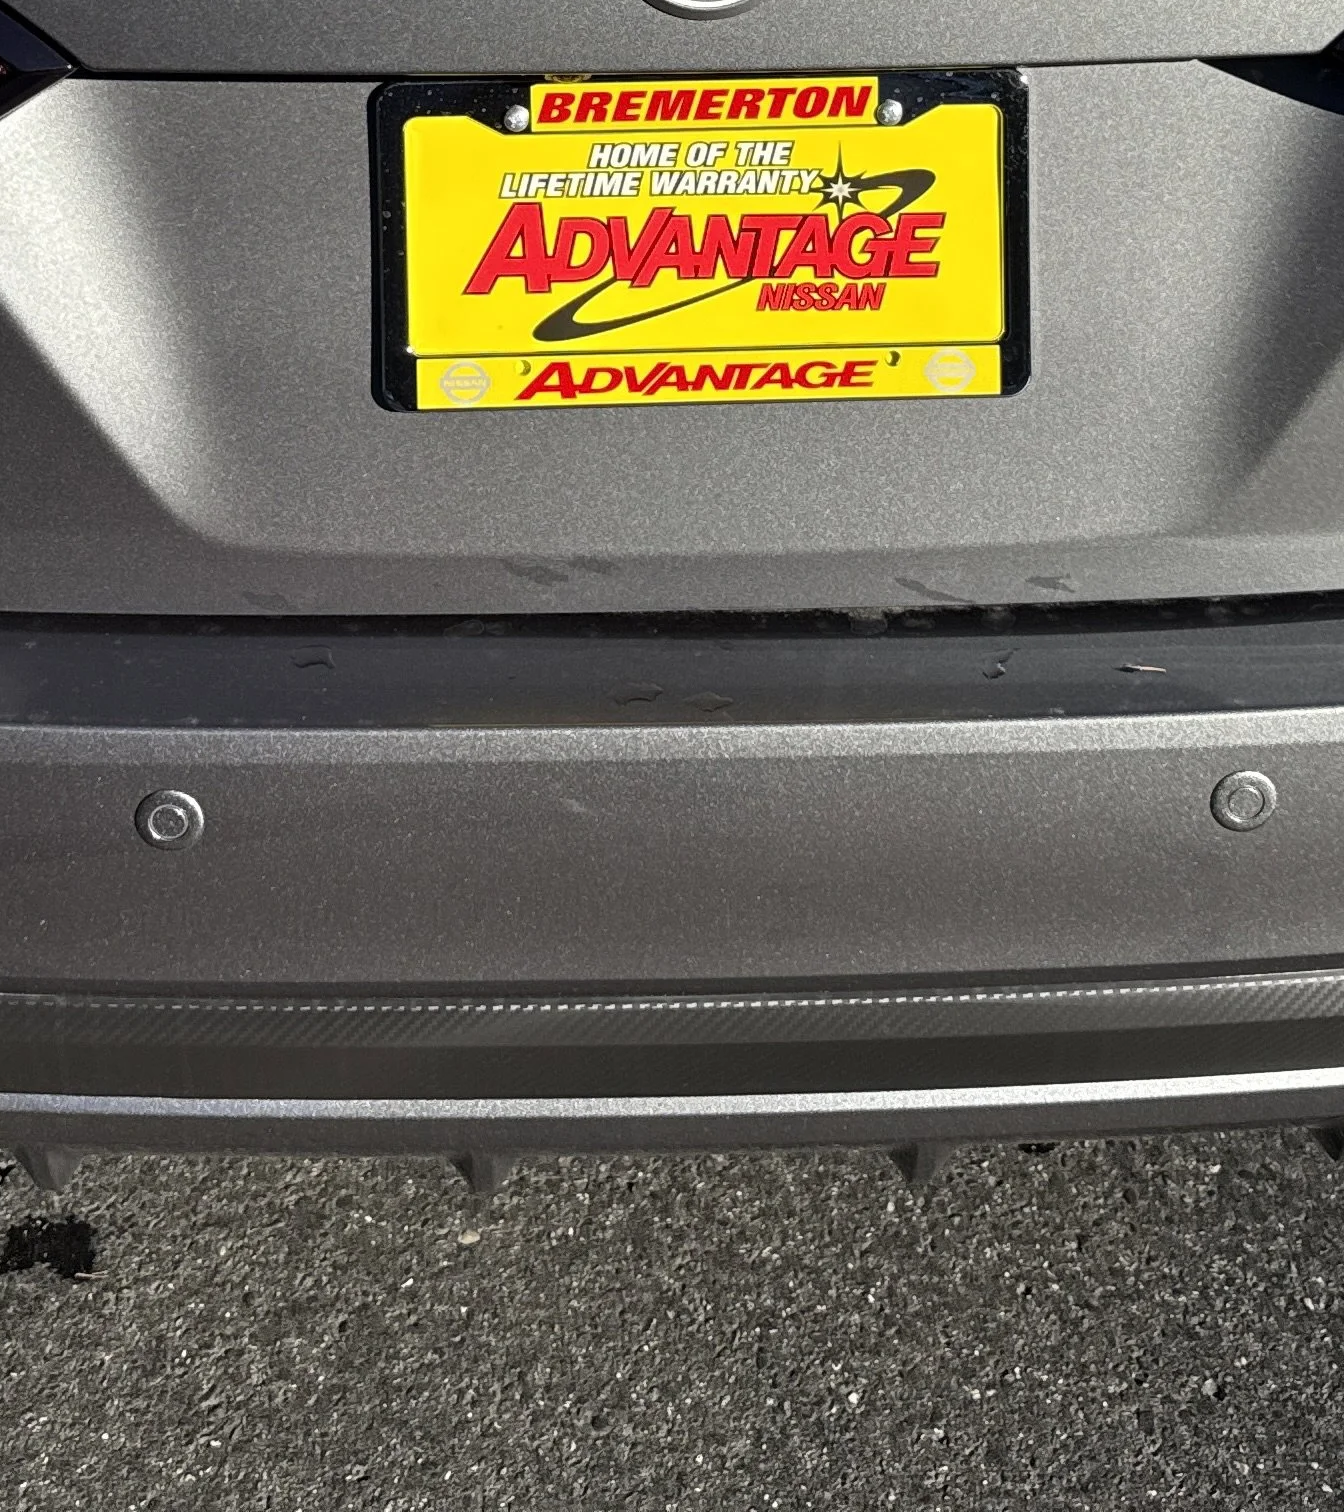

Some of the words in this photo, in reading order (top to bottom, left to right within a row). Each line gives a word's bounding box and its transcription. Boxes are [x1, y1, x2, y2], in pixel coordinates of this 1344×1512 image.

[536, 85, 872, 125] BREMERTON
[588, 143, 678, 168] HOME
[686, 142, 731, 167] OF
[735, 140, 795, 166] THE
[499, 171, 641, 199] LIFETIME
[650, 168, 822, 197] WARRANTY
[462, 202, 948, 295] ADVANTAGE
[755, 281, 887, 312] NISSAN
[516, 359, 879, 401] ADVANTAGE
